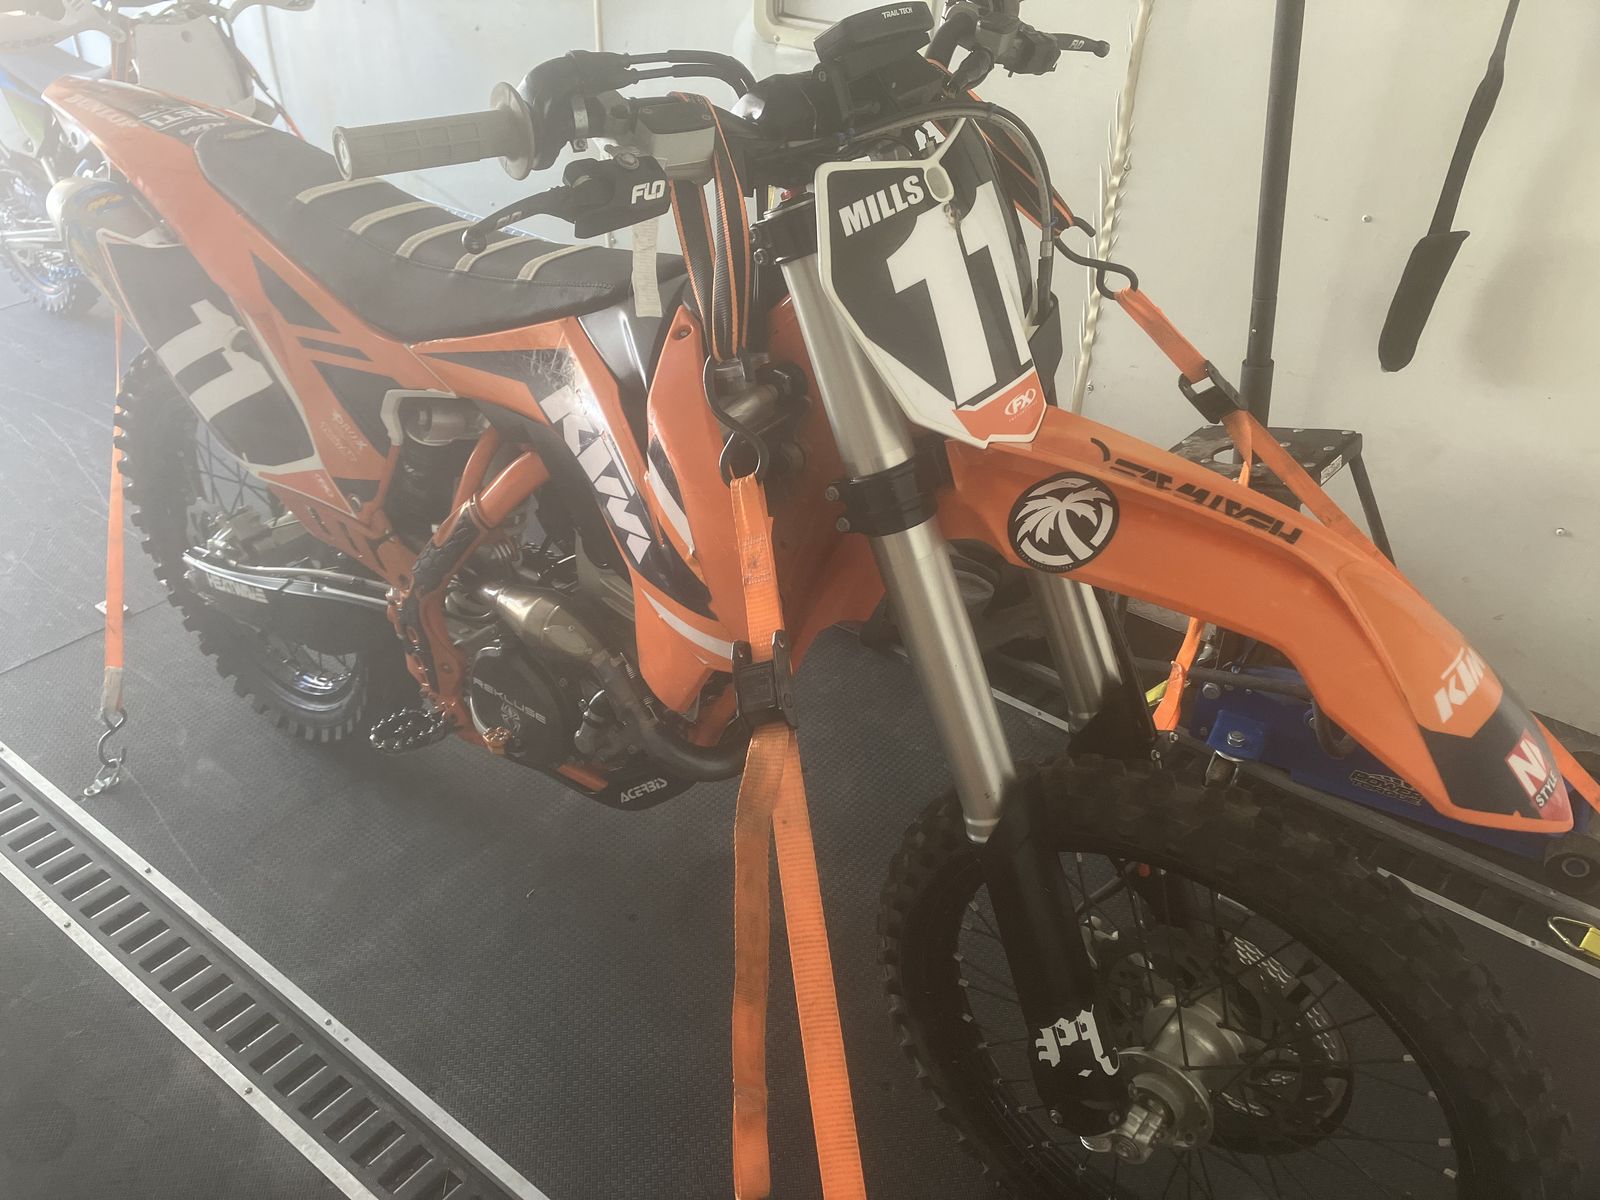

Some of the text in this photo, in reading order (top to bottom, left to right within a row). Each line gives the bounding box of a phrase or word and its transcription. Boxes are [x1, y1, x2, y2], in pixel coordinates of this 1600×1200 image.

[882, 7, 913, 19] TRAIL TECH
[1070, 39, 1085, 50] FLO
[631, 179, 666, 205] FLO
[838, 175, 925, 238] MILLS
[886, 180, 1033, 408] 11
[156, 299, 274, 423] 11
[539, 384, 651, 565] KTM
[473, 676, 547, 725] REKLUSE
[1433, 646, 1486, 724] KTM
